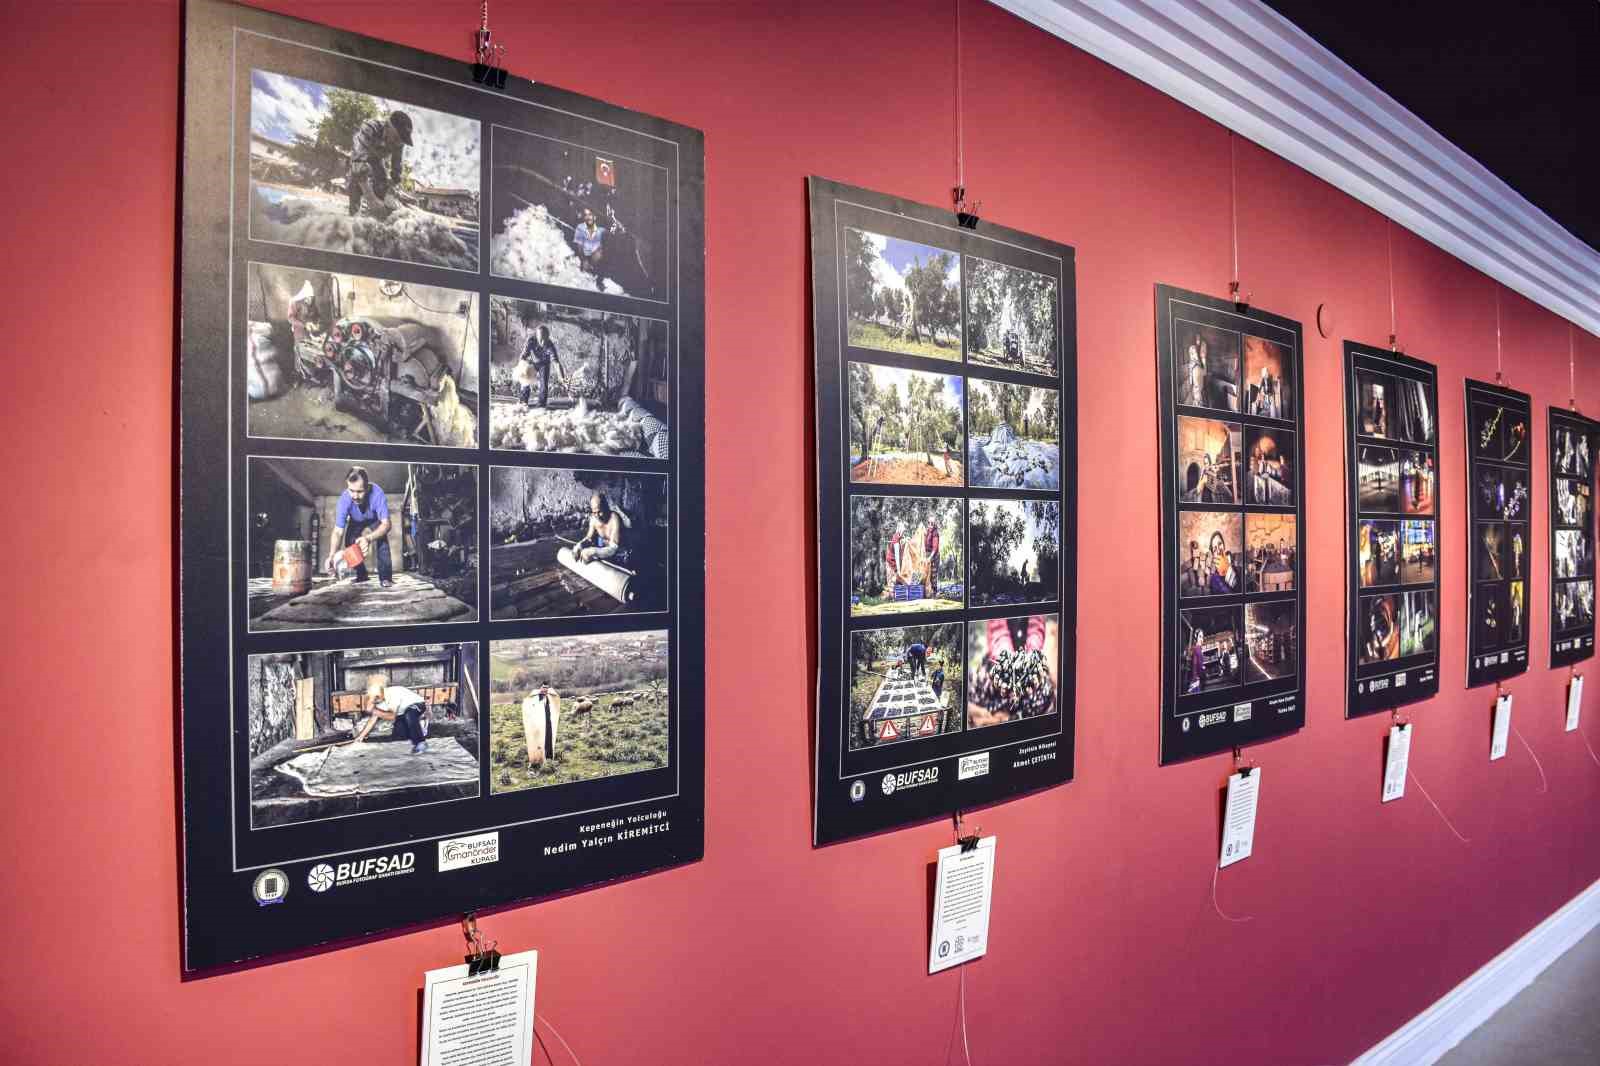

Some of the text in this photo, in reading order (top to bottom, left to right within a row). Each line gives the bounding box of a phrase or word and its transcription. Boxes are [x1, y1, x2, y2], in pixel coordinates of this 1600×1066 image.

[896, 766, 939, 787] BUFSAD
[467, 838, 497, 849] BUFSAD
[544, 842, 577, 856] Nedim
[581, 835, 613, 848] Yalçın
[336, 852, 415, 880] BUFSAD
